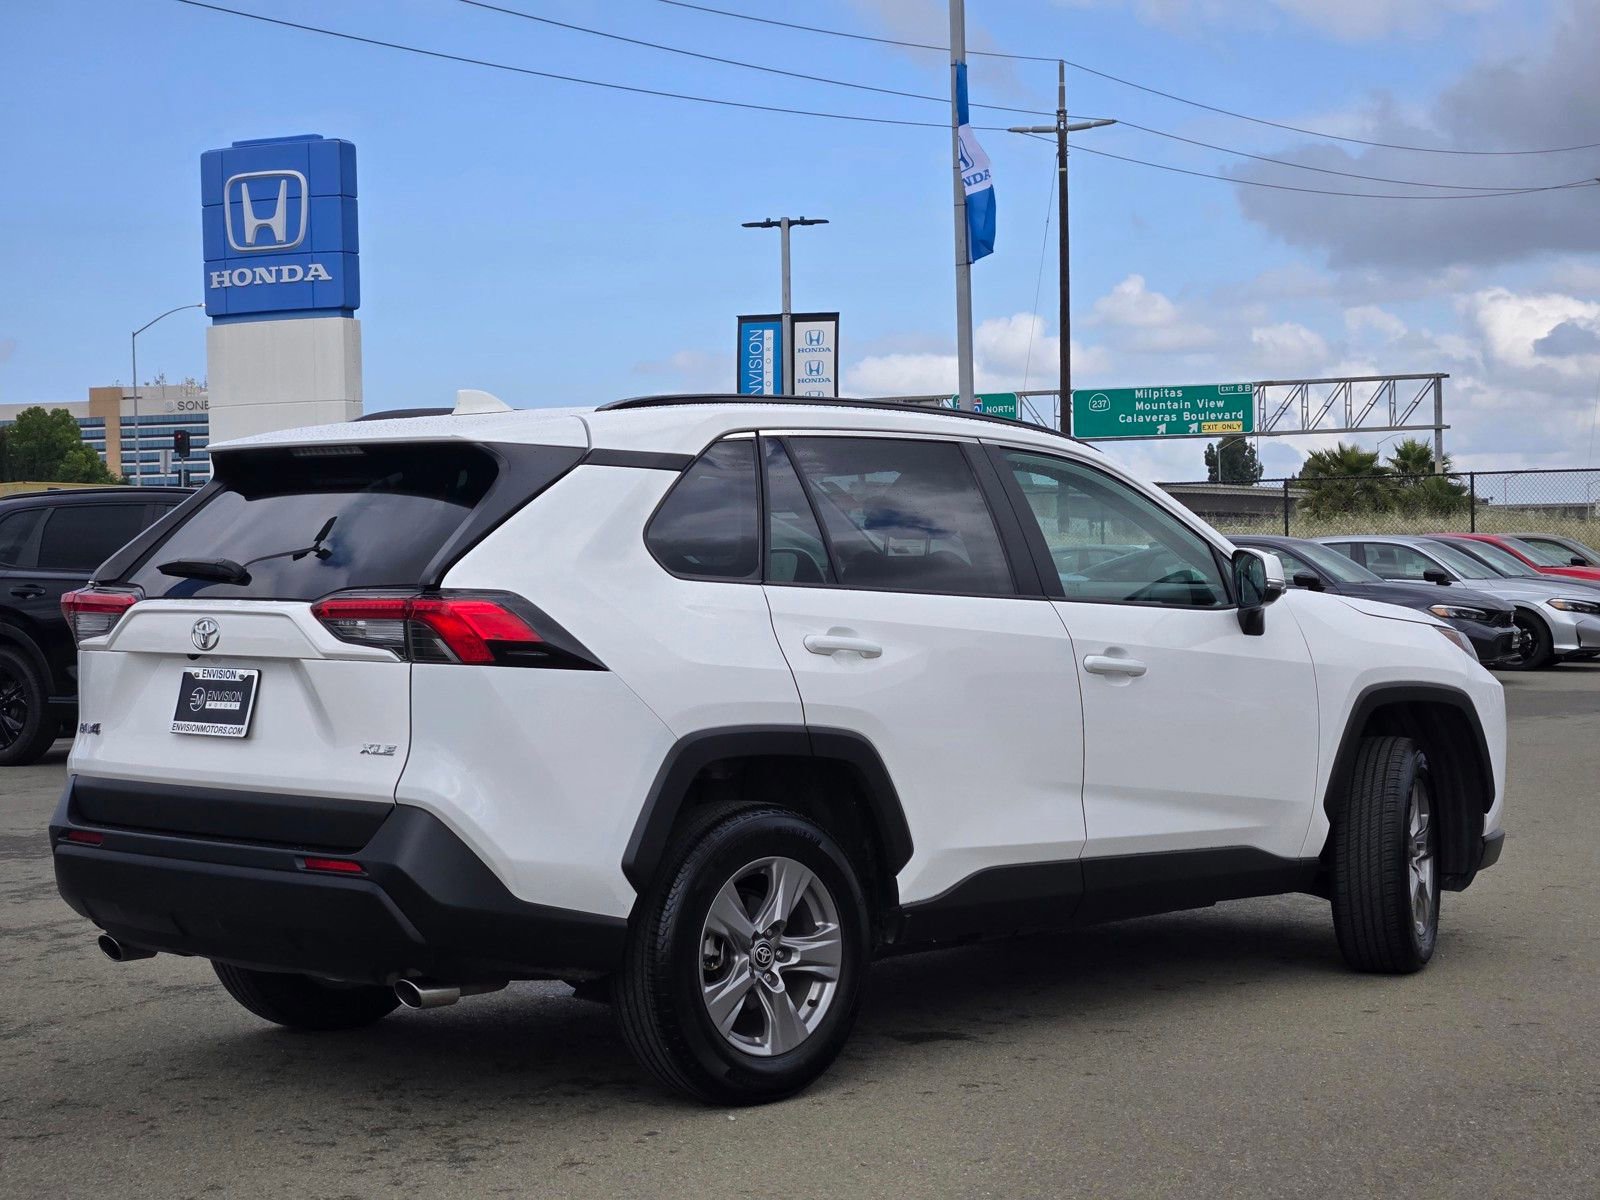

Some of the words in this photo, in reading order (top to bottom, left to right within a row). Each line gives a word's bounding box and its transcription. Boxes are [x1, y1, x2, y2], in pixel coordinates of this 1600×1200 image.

[210, 263, 332, 289] HONDA
[1135, 388, 1183, 400] Milpitas
[986, 405, 1015, 414] NORTH
[1092, 400, 1107, 409] 237
[1135, 400, 1191, 411] Mountain
[1197, 399, 1225, 408] View
[1119, 413, 1177, 423] Calaveras
[1183, 410, 1243, 421] Boulevard
[201, 668, 237, 680] ENVISION
[206, 690, 243, 702] ENVISION
[171, 722, 244, 735] ENVISIONMOTORS.COM
[360, 743, 398, 757] XLE
